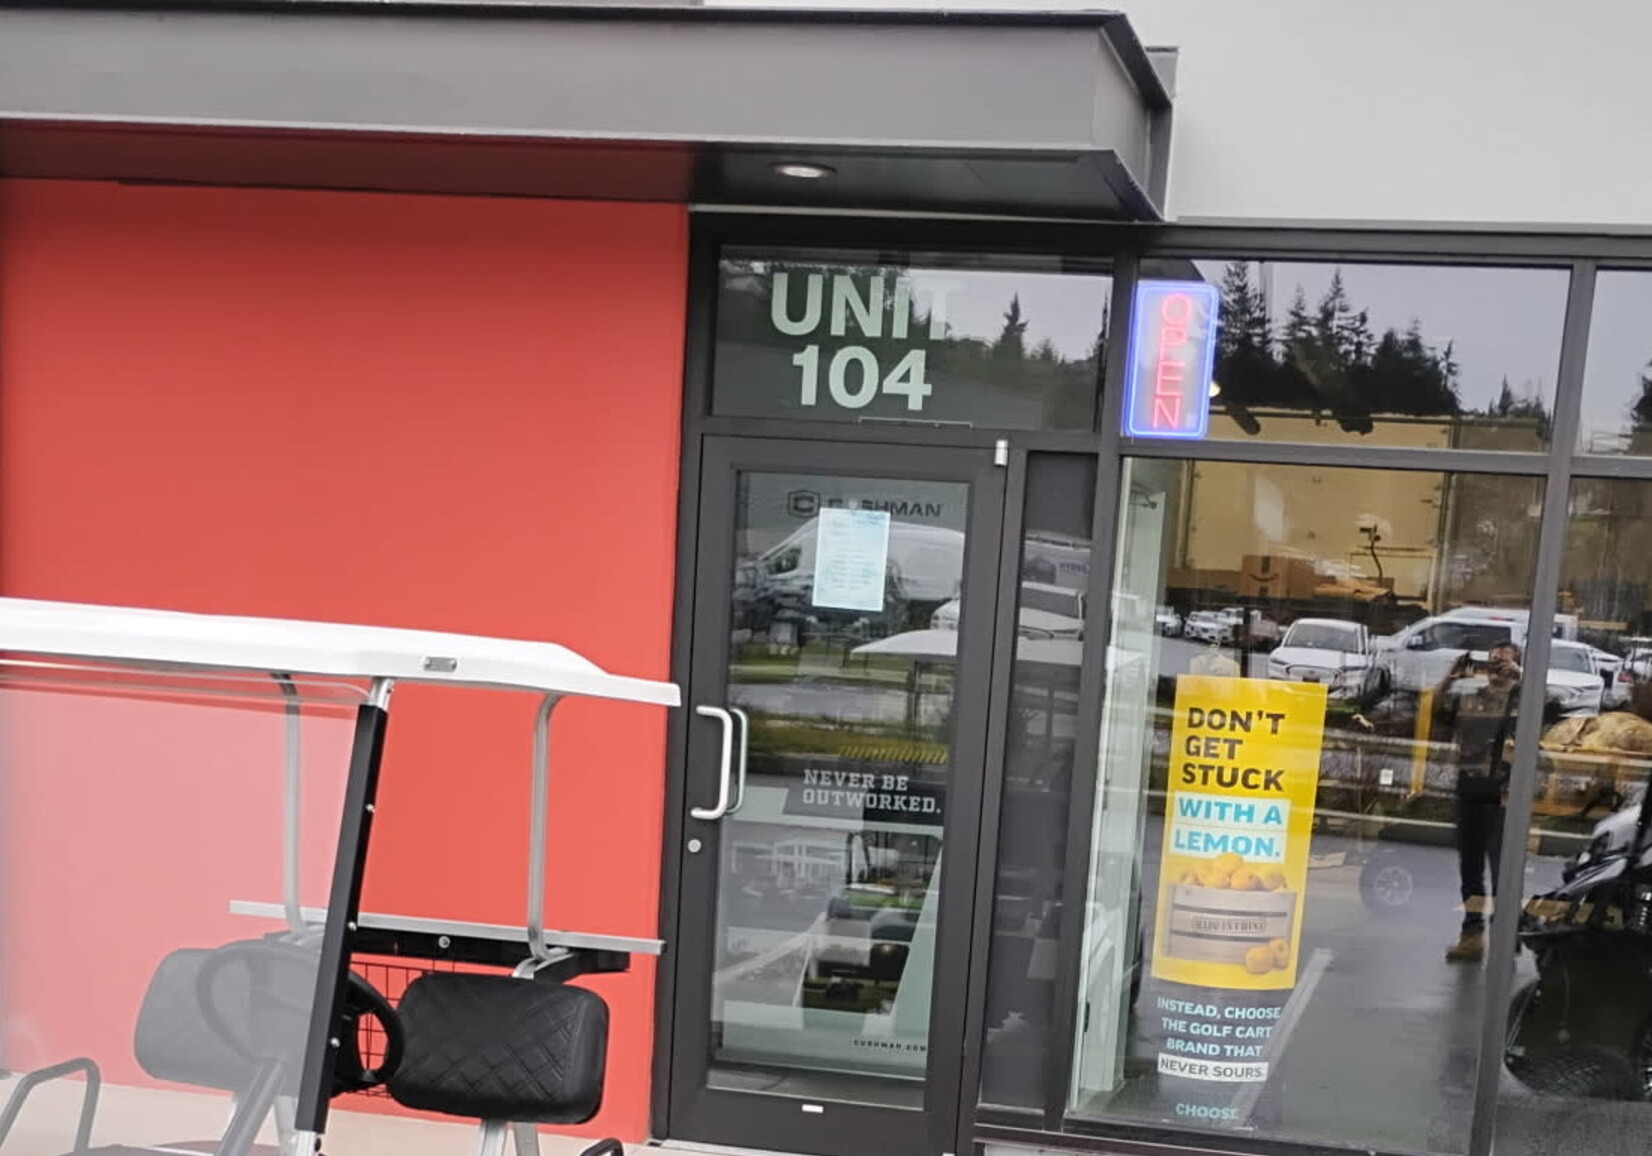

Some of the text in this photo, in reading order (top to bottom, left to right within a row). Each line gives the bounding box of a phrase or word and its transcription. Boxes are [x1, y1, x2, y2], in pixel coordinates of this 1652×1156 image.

[771, 271, 965, 340] UNIT
[1153, 292, 1192, 430] OPEN
[792, 344, 933, 411] 104
[828, 497, 942, 518] CSHMAN
[1186, 706, 1286, 735] DON'T
[1185, 735, 1243, 761] GET
[803, 768, 910, 791] NEVER BE
[1181, 762, 1286, 792] STUCK
[802, 788, 941, 814] OUTWORKED.
[1178, 797, 1283, 825] WITH A
[1174, 829, 1281, 858] LEMON.
[1157, 996, 1283, 1020] INSTEAD, CHOOSE
[1161, 1016, 1273, 1039] THE GOLF CART
[1166, 1037, 1263, 1057] BRAND THAT
[1160, 1057, 1209, 1077] NEVER
[1175, 1103, 1240, 1120] CHOOSE
